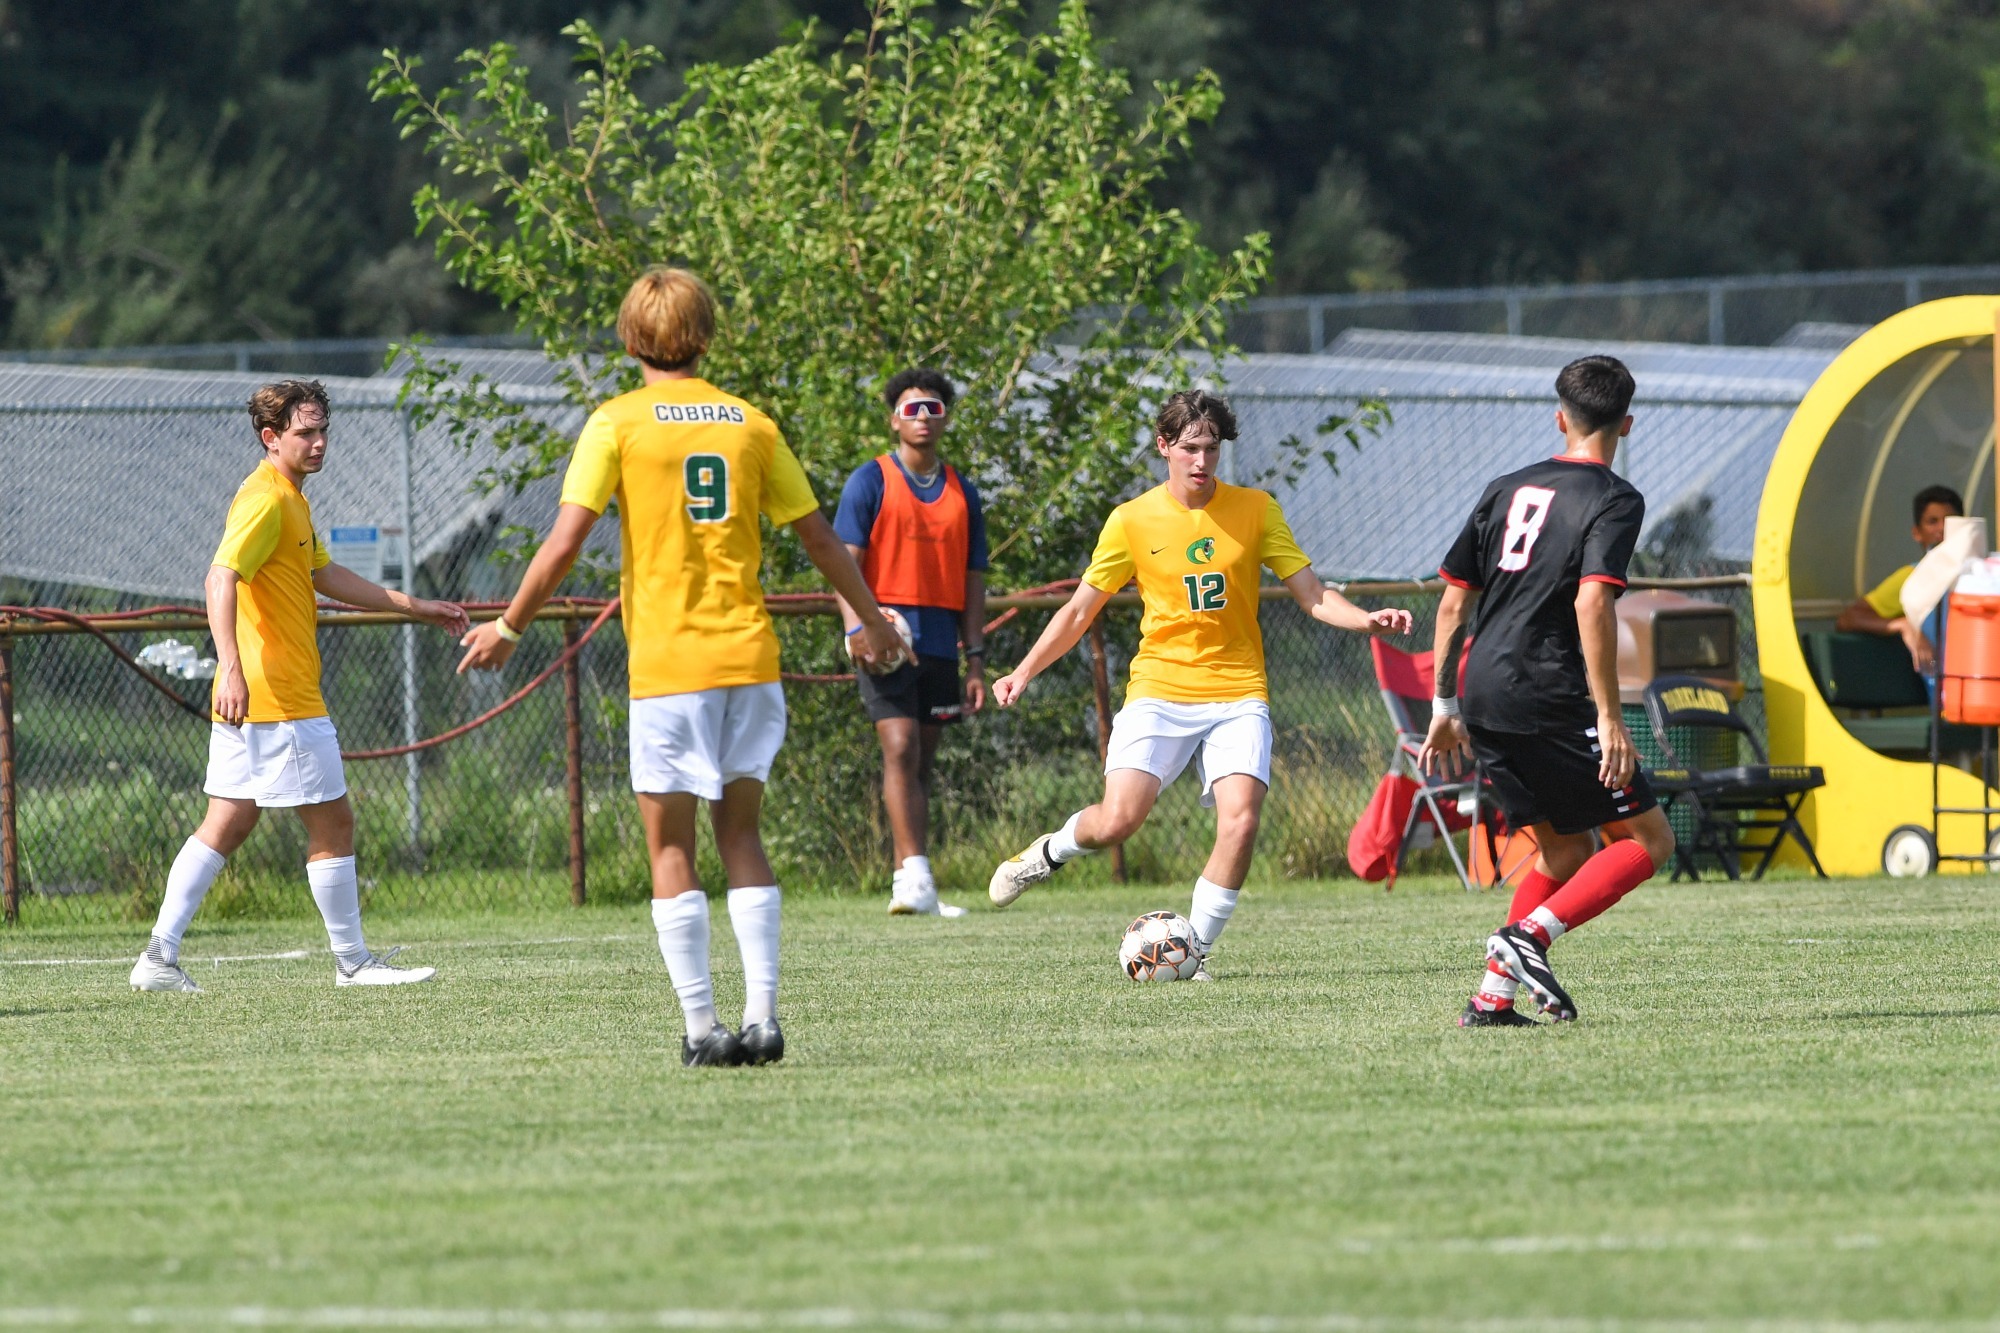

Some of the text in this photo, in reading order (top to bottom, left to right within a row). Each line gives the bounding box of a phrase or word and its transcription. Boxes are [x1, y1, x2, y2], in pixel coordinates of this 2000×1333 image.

[654, 403, 746, 424] COBRAS
[683, 452, 729, 524] 9
[1497, 485, 1556, 573] 8
[1183, 572, 1228, 612] 12
